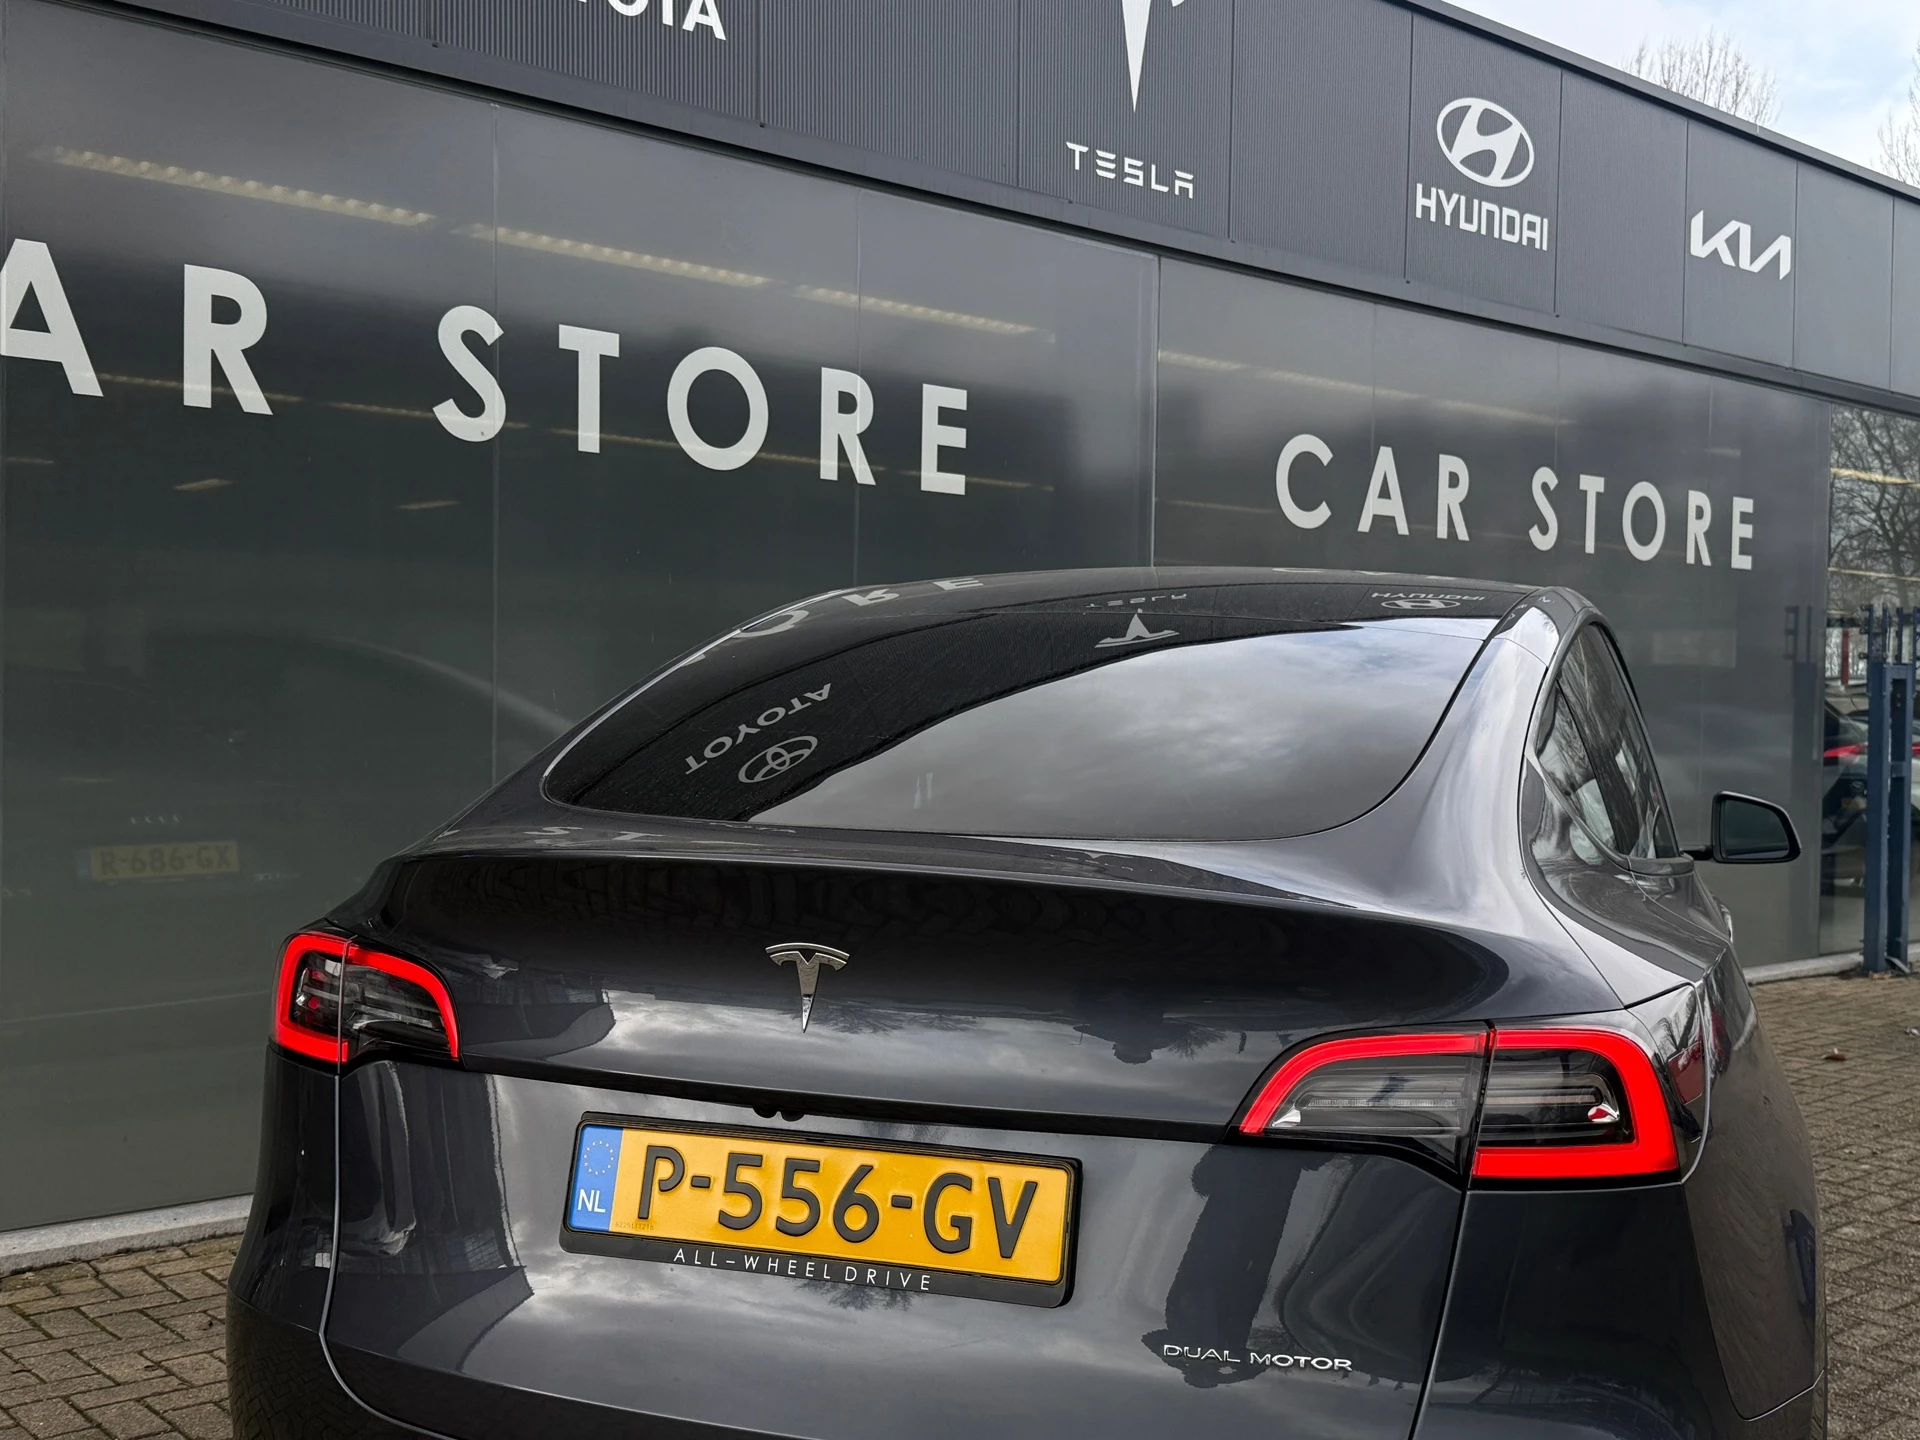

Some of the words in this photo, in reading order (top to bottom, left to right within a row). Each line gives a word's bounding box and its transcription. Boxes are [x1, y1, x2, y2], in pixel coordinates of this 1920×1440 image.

[1066, 141, 1194, 199] TESLA
[1415, 183, 1549, 251] HYUNDAI
[1691, 210, 1792, 280] KIA
[433, 305, 968, 496] STORE
[1276, 434, 1470, 541] CAR
[1528, 466, 1754, 570] STORE
[577, 1188, 606, 1213] NL
[637, 1145, 1038, 1259] P-556-GV
[673, 1248, 831, 1280] ALL-WHEEL
[844, 1266, 931, 1291] DRIVE
[1163, 1344, 1241, 1363] DUAL
[1250, 1352, 1353, 1371] MOTOR
